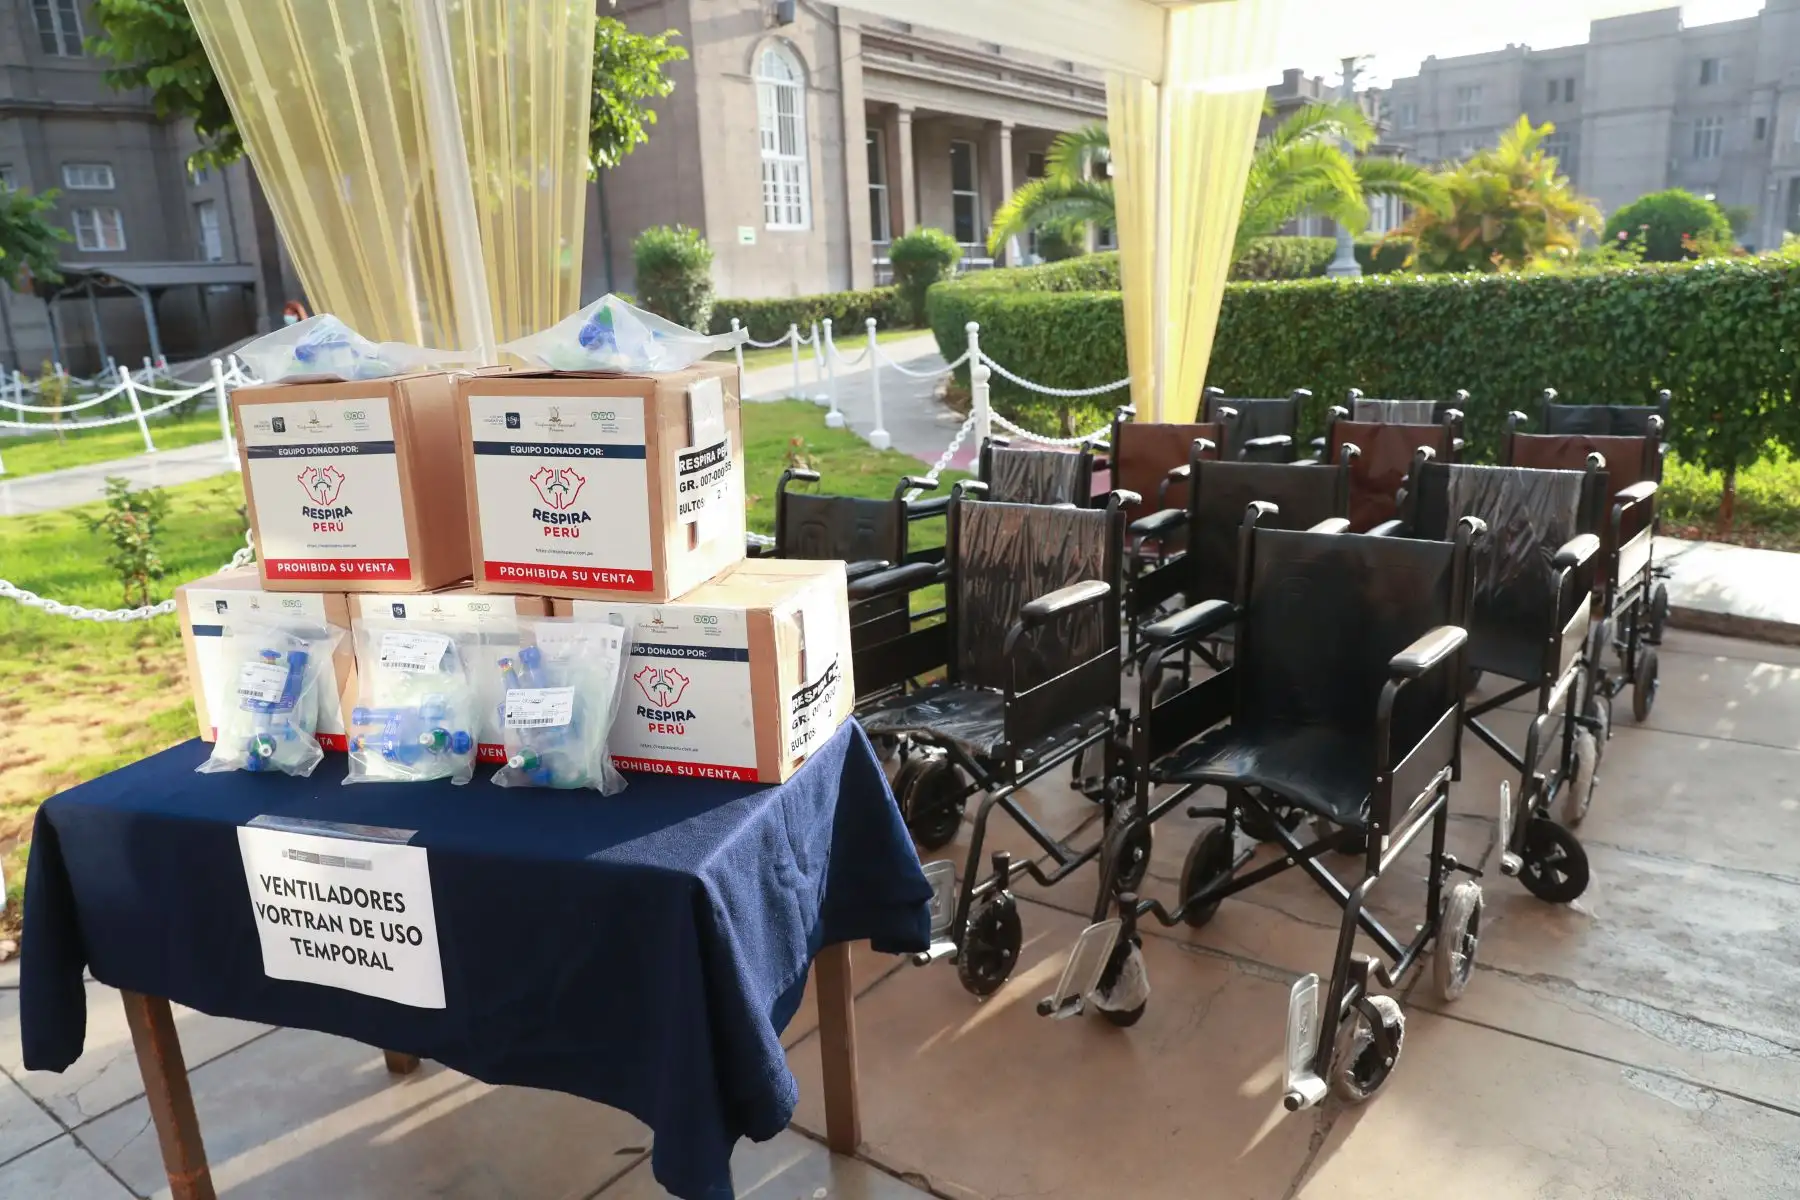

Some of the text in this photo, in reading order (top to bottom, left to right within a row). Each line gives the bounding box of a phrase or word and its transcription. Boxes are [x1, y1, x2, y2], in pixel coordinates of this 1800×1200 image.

[278, 445, 359, 456] EQUIPO DONADO POR:
[510, 445, 604, 456] EQUIPO DONADO POR:
[679, 450, 716, 472] RESPIRA
[679, 480, 699, 493] GR.
[302, 505, 353, 520] RESPIRA
[532, 508, 592, 525] RESPIRA
[312, 520, 344, 532] PERÚ
[543, 525, 580, 538] PERÚ
[277, 562, 395, 573] PROHIBIDA SU VENTA
[499, 566, 635, 584] PROHIBIDA SU VENTA
[647, 647, 685, 657] DONADO
[686, 648, 708, 658] POR:
[636, 705, 696, 722] RESPIRA
[648, 722, 685, 735] PERÚ
[612, 759, 741, 780] ROHIBIDA SU VENTA
[259, 873, 406, 914] VENTILADORES
[255, 901, 423, 946] VORTRAN DE USO
[289, 937, 394, 972] TEMPORAL
